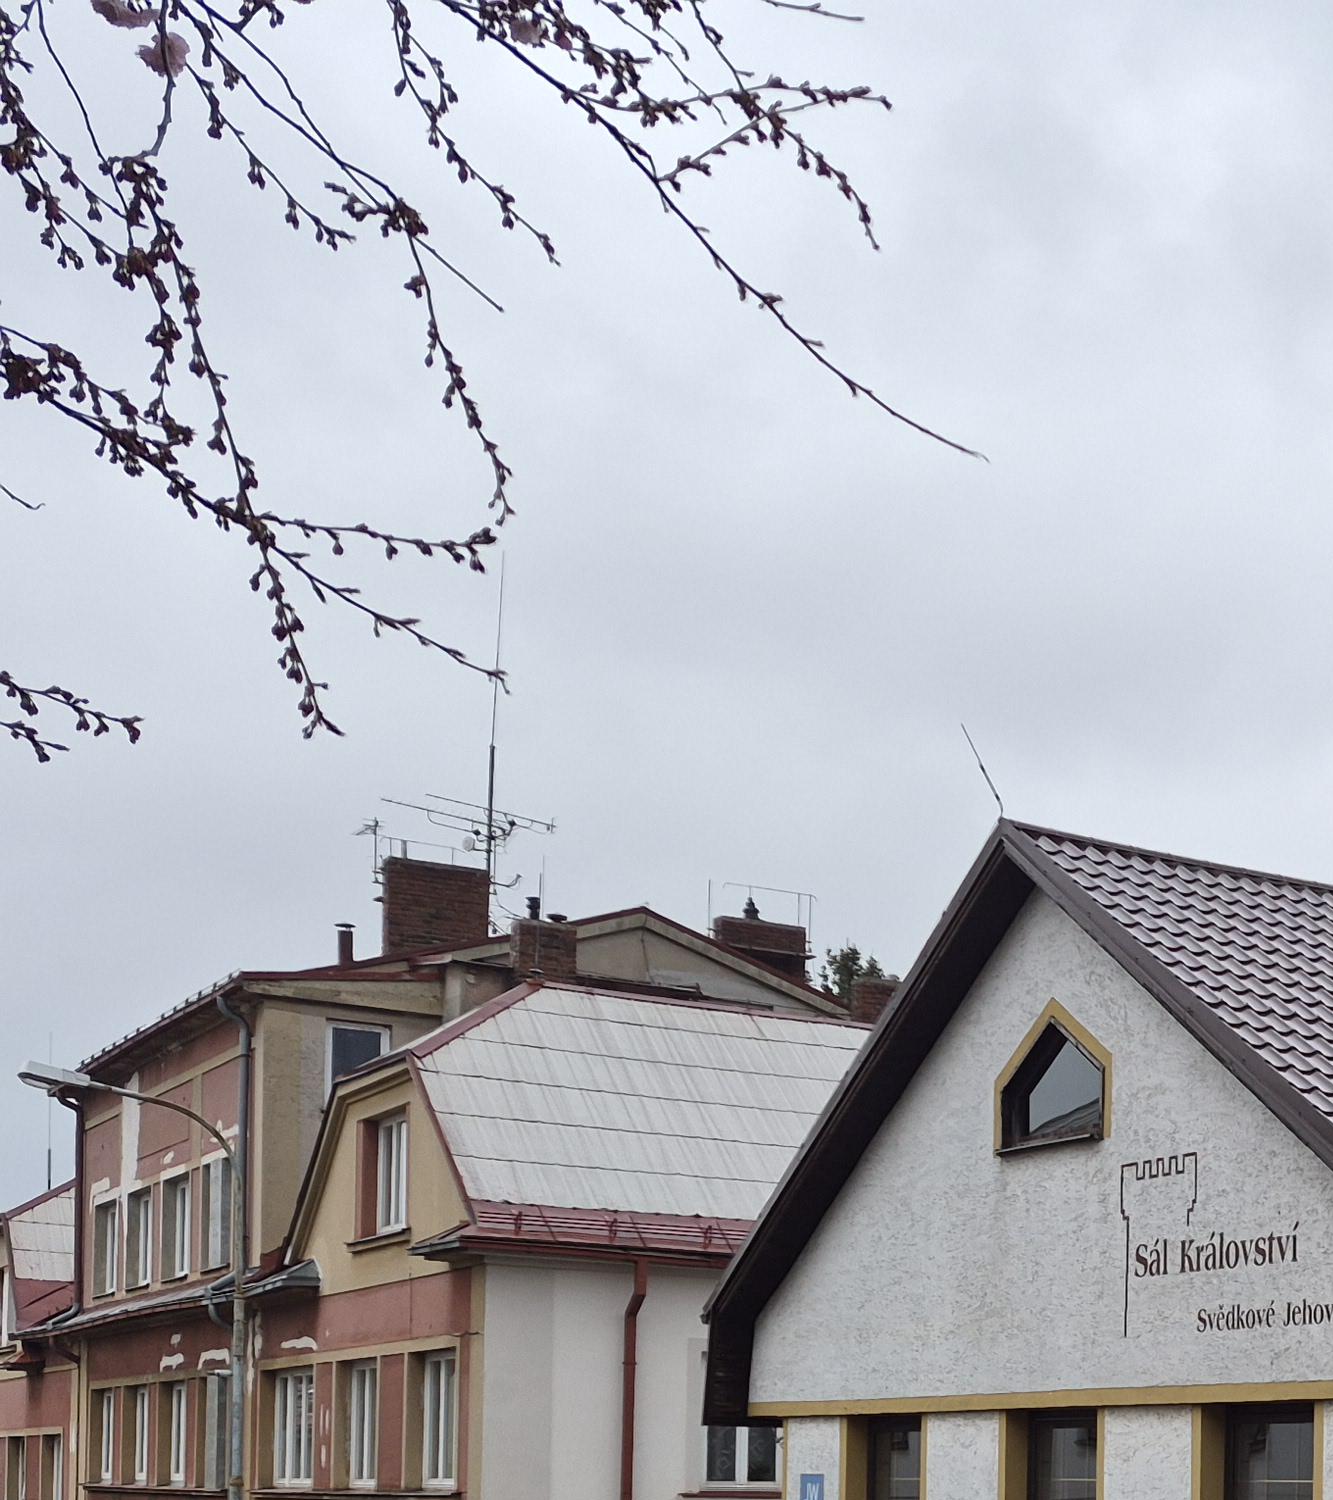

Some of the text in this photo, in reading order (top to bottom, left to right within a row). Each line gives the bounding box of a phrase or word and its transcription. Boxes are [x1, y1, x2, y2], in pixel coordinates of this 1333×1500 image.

[1134, 1221, 1299, 1278] Sál Království
[1197, 1301, 1275, 1333] Svědkové
